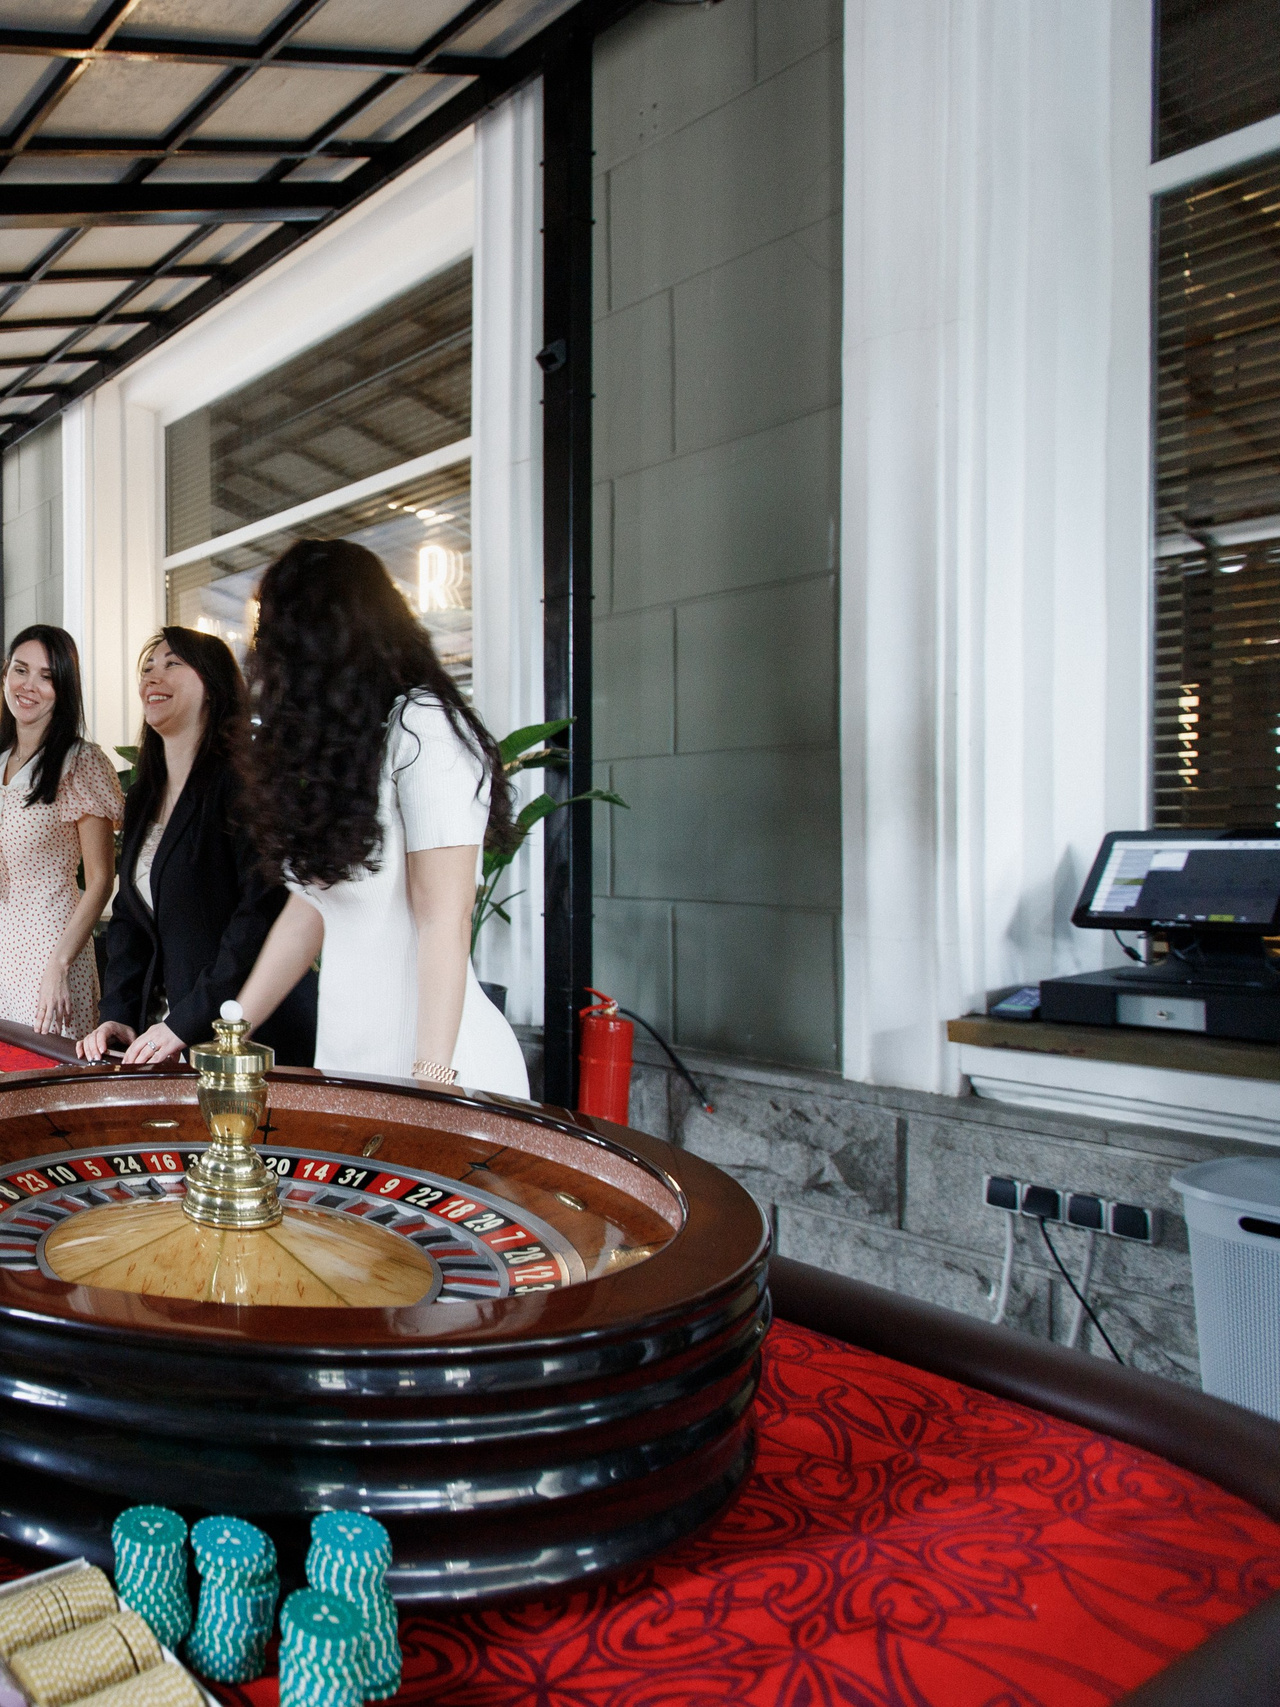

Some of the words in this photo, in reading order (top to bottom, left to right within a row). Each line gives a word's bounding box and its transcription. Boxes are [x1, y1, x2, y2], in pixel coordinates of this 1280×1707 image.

[16, 1173, 48, 1192] 23
[46, 1165, 77, 1184] 10
[83, 1161, 102, 1177] 5
[113, 1156, 142, 1174] 24
[150, 1154, 177, 1171] 16
[265, 1157, 291, 1175] 20
[303, 1162, 330, 1181] 14
[338, 1168, 367, 1187] 31
[380, 1178, 400, 1194] 9
[405, 1187, 443, 1207] 22
[439, 1198, 476, 1219] 18
[464, 1213, 505, 1232] 29
[490, 1230, 526, 1244] 7
[504, 1246, 546, 1264] 28
[514, 1265, 555, 1282] 12
